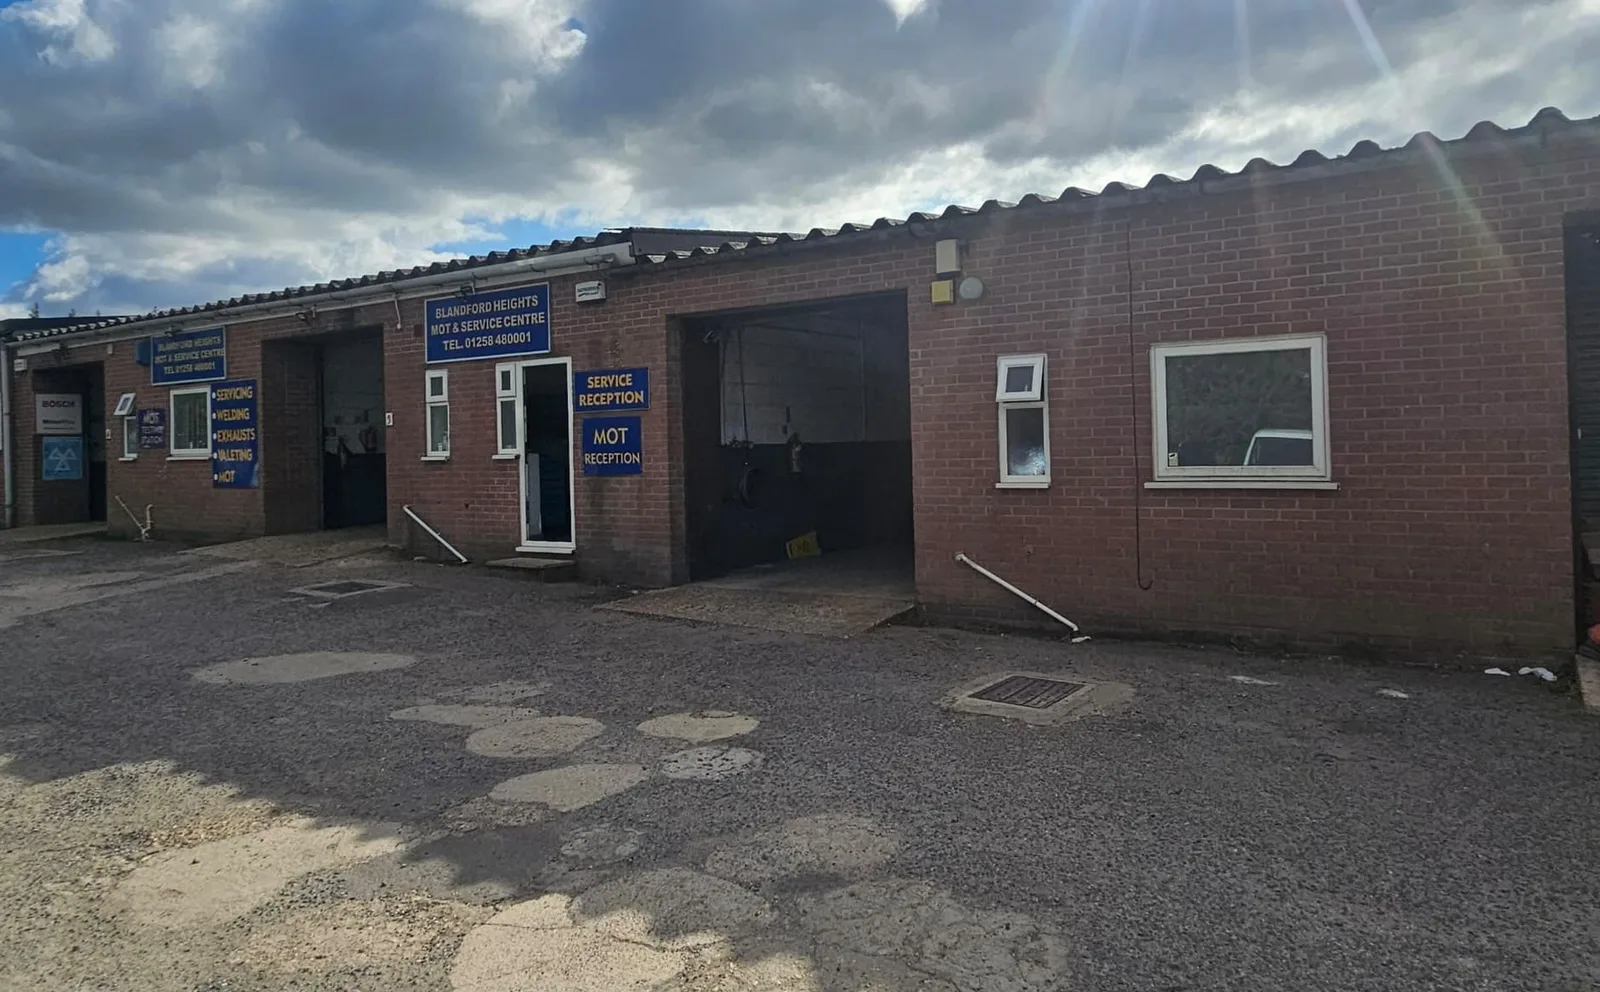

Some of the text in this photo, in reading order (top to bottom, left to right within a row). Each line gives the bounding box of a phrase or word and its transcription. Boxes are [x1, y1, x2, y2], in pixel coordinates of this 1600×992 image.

[435, 294, 539, 319] BLANDFORD HEIGHTS
[430, 311, 546, 336] MOT & SERVICE CENTRE
[442, 331, 532, 351] TEL. 01258 480001
[587, 373, 633, 389] SERVICE
[216, 386, 253, 401] SERVICING
[579, 390, 644, 407] RECEPTION
[42, 400, 75, 408] BOSCH
[216, 407, 250, 421] WELDING
[216, 427, 256, 443] EXHAUSTS
[593, 427, 629, 445] MOT
[217, 448, 253, 462] VALETING
[584, 452, 641, 465] RECEPTION
[218, 470, 235, 483] MOT
